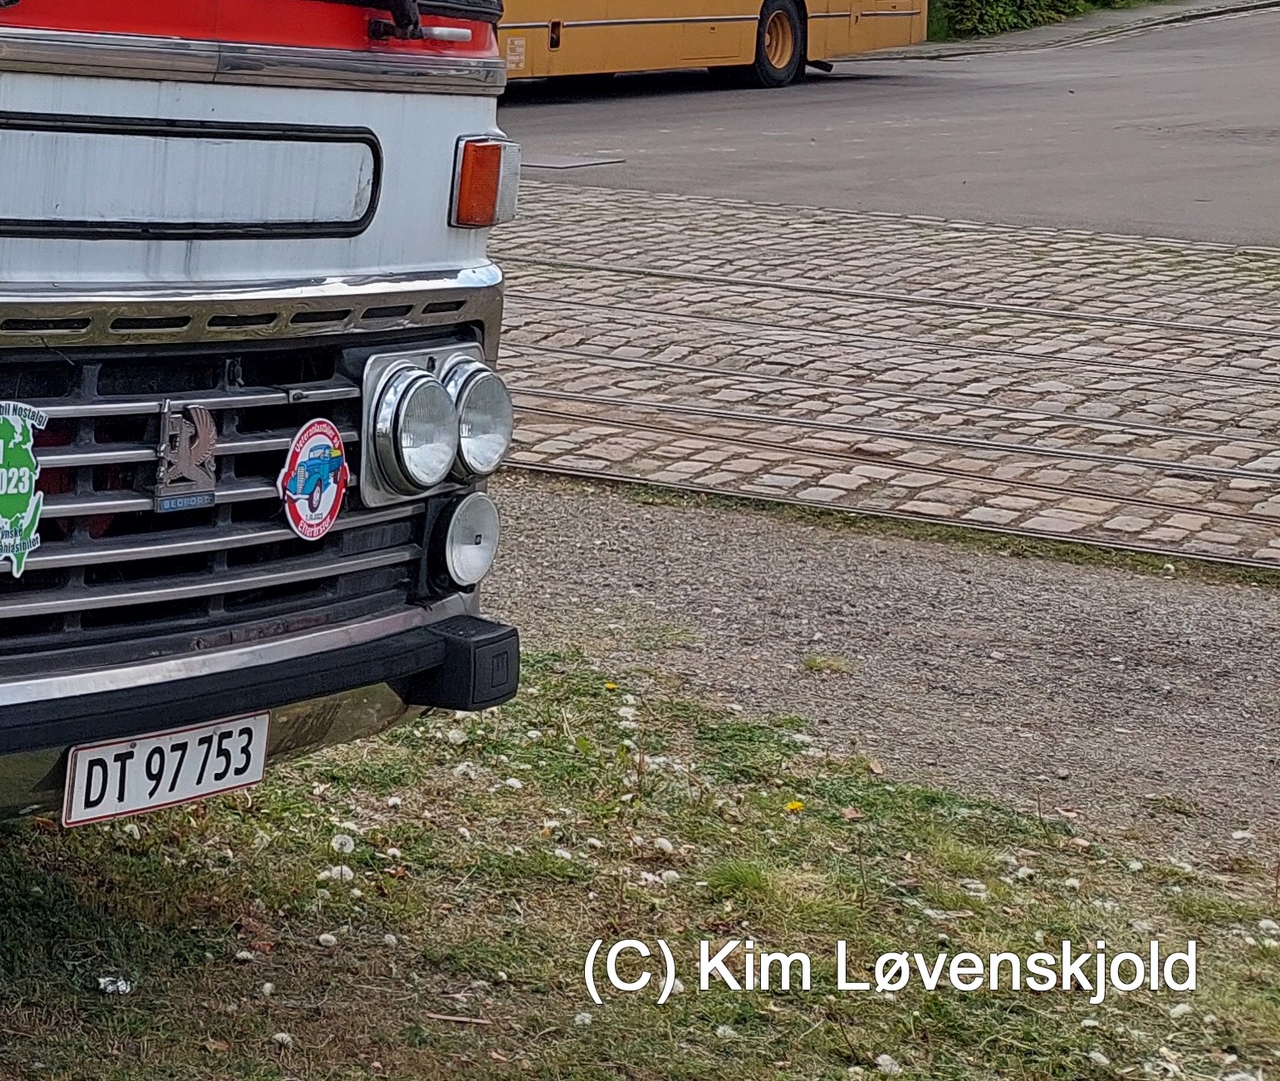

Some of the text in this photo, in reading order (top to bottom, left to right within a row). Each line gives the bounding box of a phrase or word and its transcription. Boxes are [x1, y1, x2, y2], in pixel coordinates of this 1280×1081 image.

[11, 403, 48, 428] Nostalgi
[163, 495, 213, 509] BEDFORD
[83, 725, 254, 810] DT 97 753
